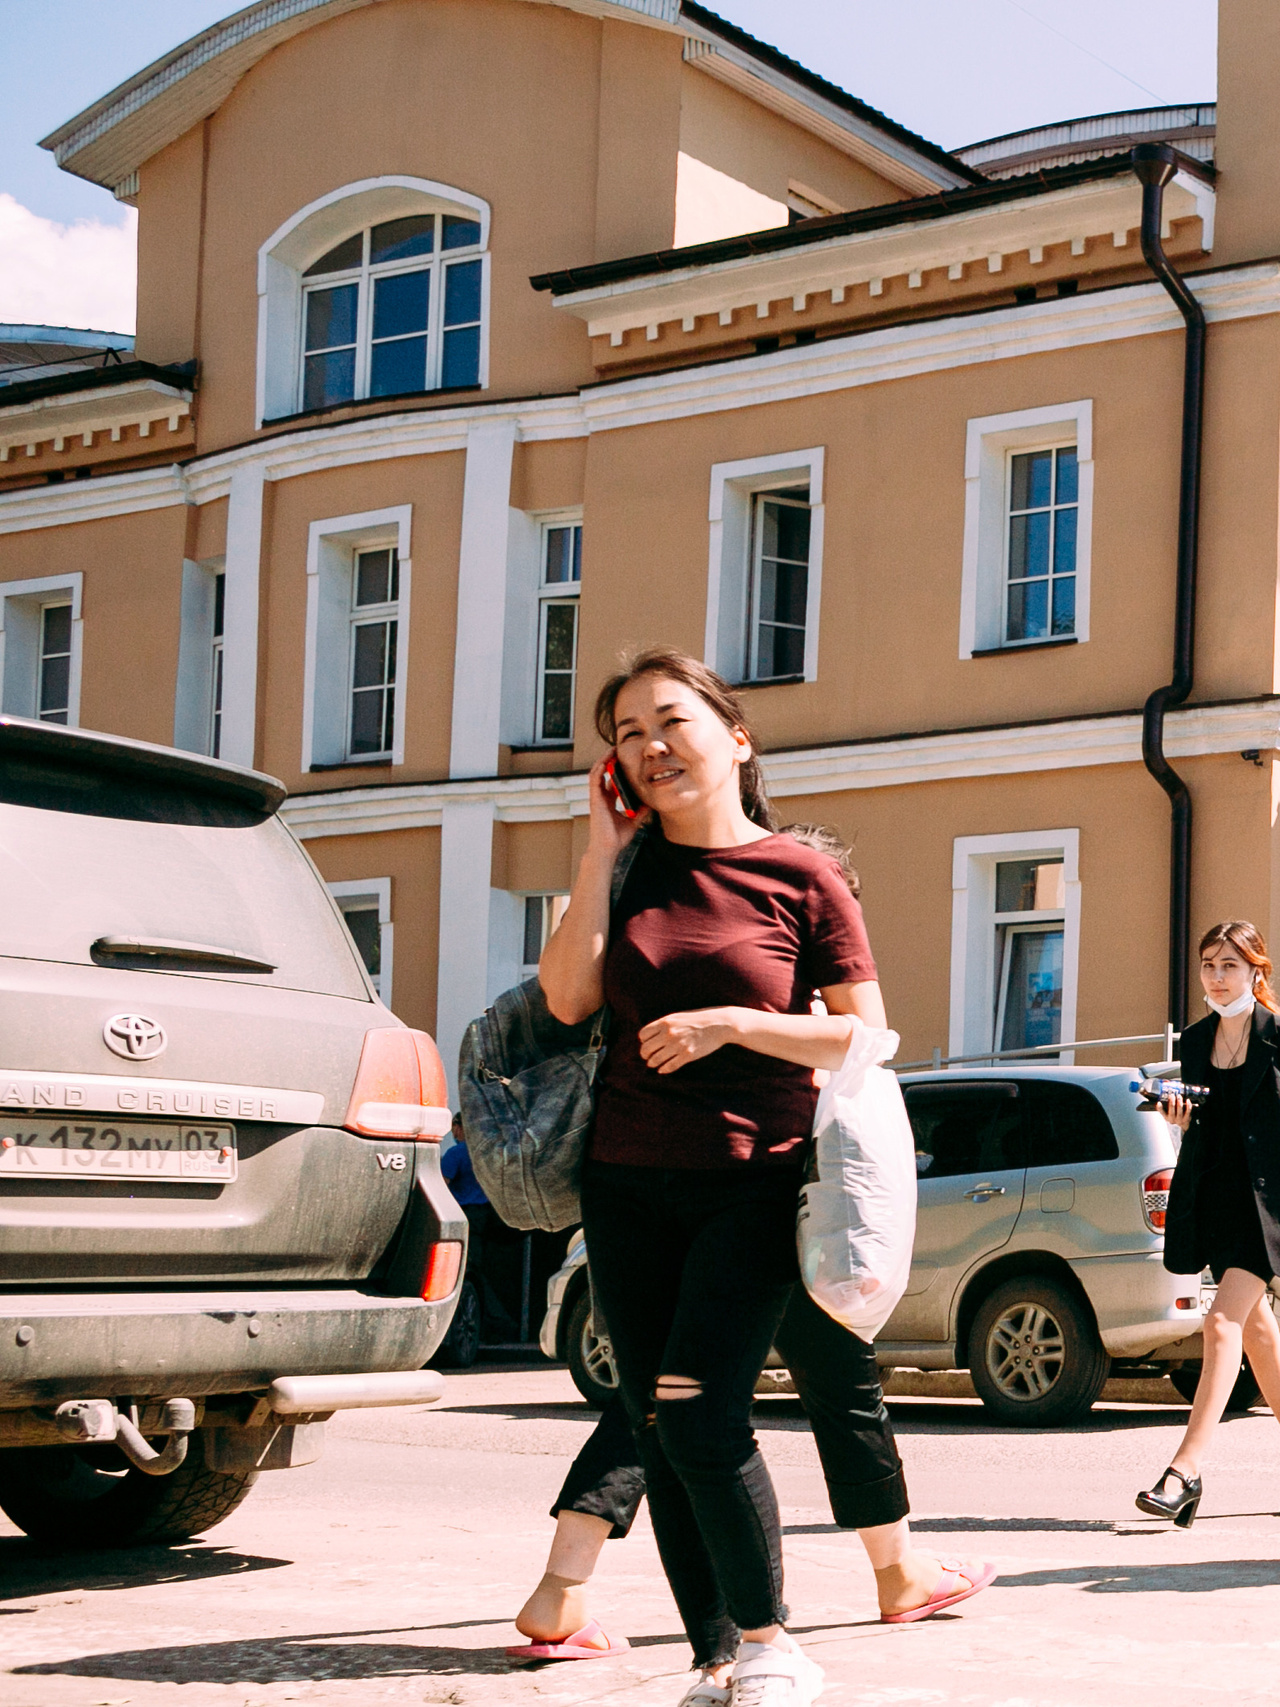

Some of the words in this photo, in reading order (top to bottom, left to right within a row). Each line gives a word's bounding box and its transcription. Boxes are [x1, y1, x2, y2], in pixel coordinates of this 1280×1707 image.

[0, 1083, 88, 1107] AND
[117, 1088, 277, 1118] CRUISER
[185, 1130, 221, 1160] 03
[184, 1161, 210, 1172] RUS
[376, 1152, 407, 1171] V8
